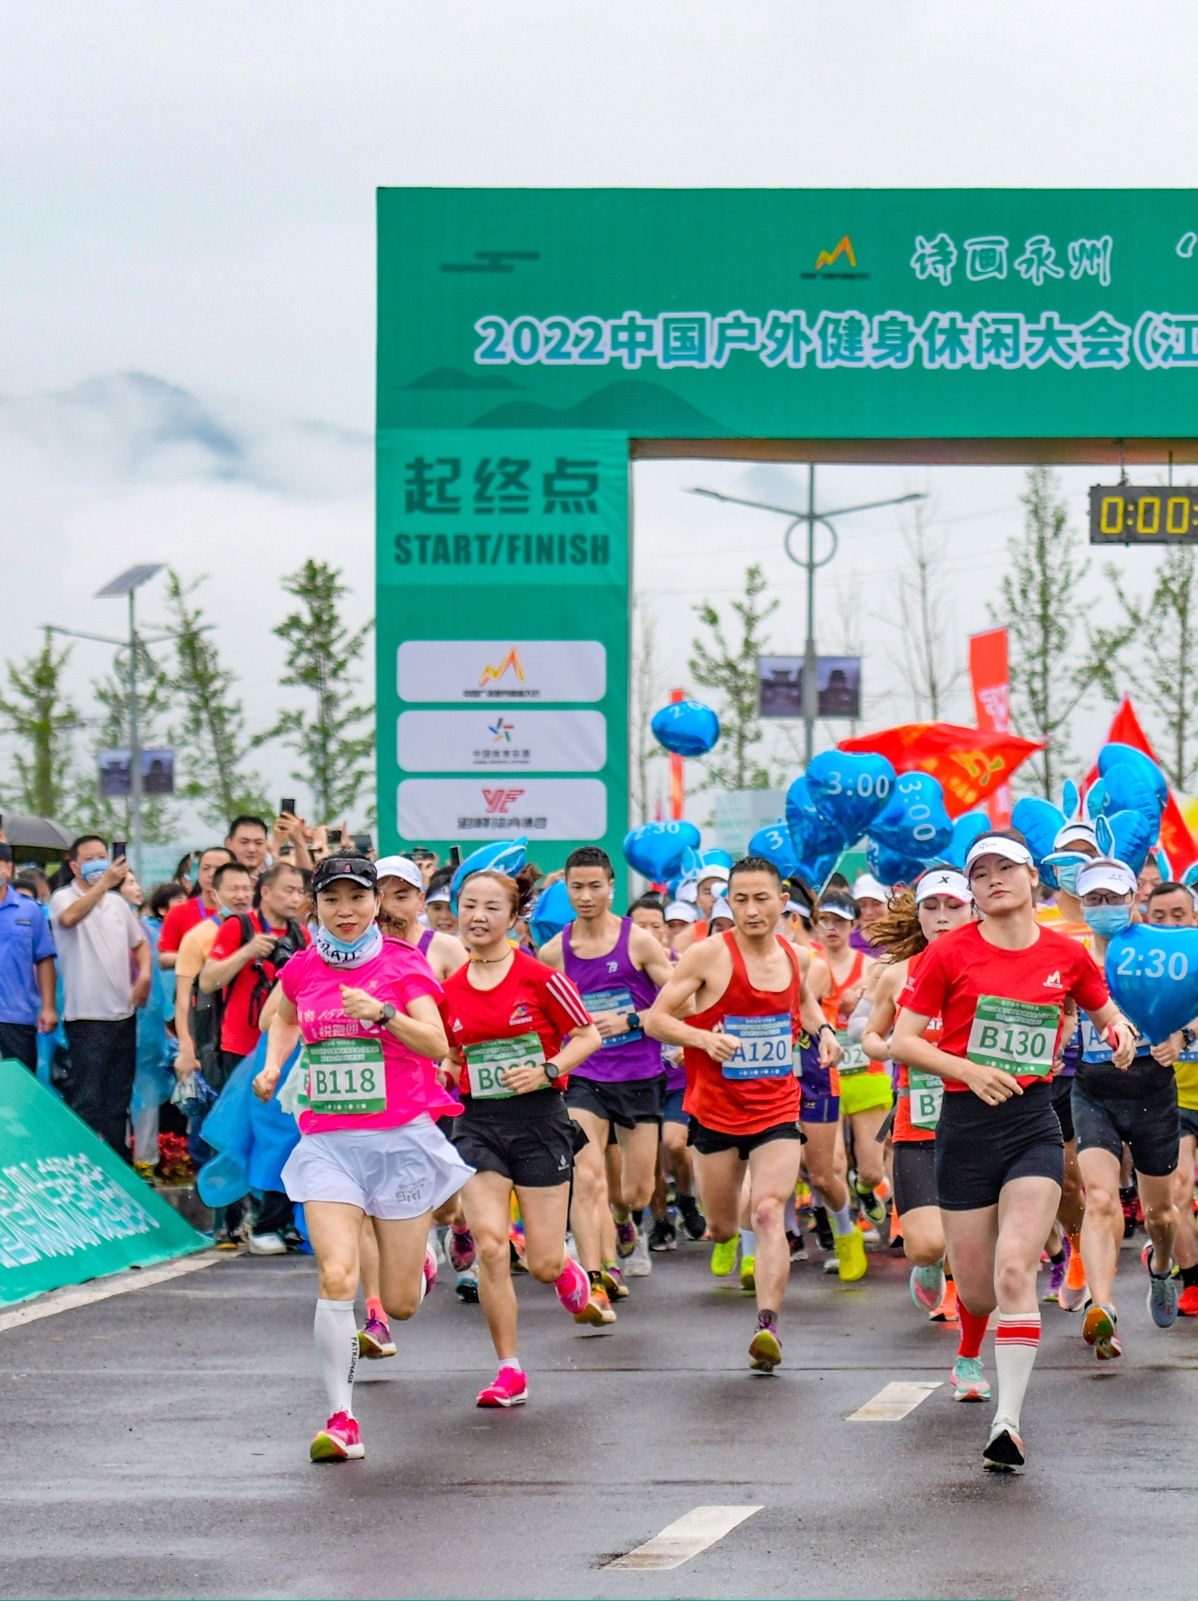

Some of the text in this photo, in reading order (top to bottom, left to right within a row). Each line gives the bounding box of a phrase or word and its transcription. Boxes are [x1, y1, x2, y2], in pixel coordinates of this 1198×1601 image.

[910, 233, 1113, 285] 诗画永州
[403, 456, 601, 516] 起终点
[393, 532, 611, 566] START/FINISH
[827, 770, 890, 799] 3:00
[898, 779, 937, 842] 3:00
[1116, 947, 1189, 981] 2:30
[730, 1039, 787, 1063] A120
[979, 1025, 1047, 1058] B130
[315, 1068, 377, 1095] B118
